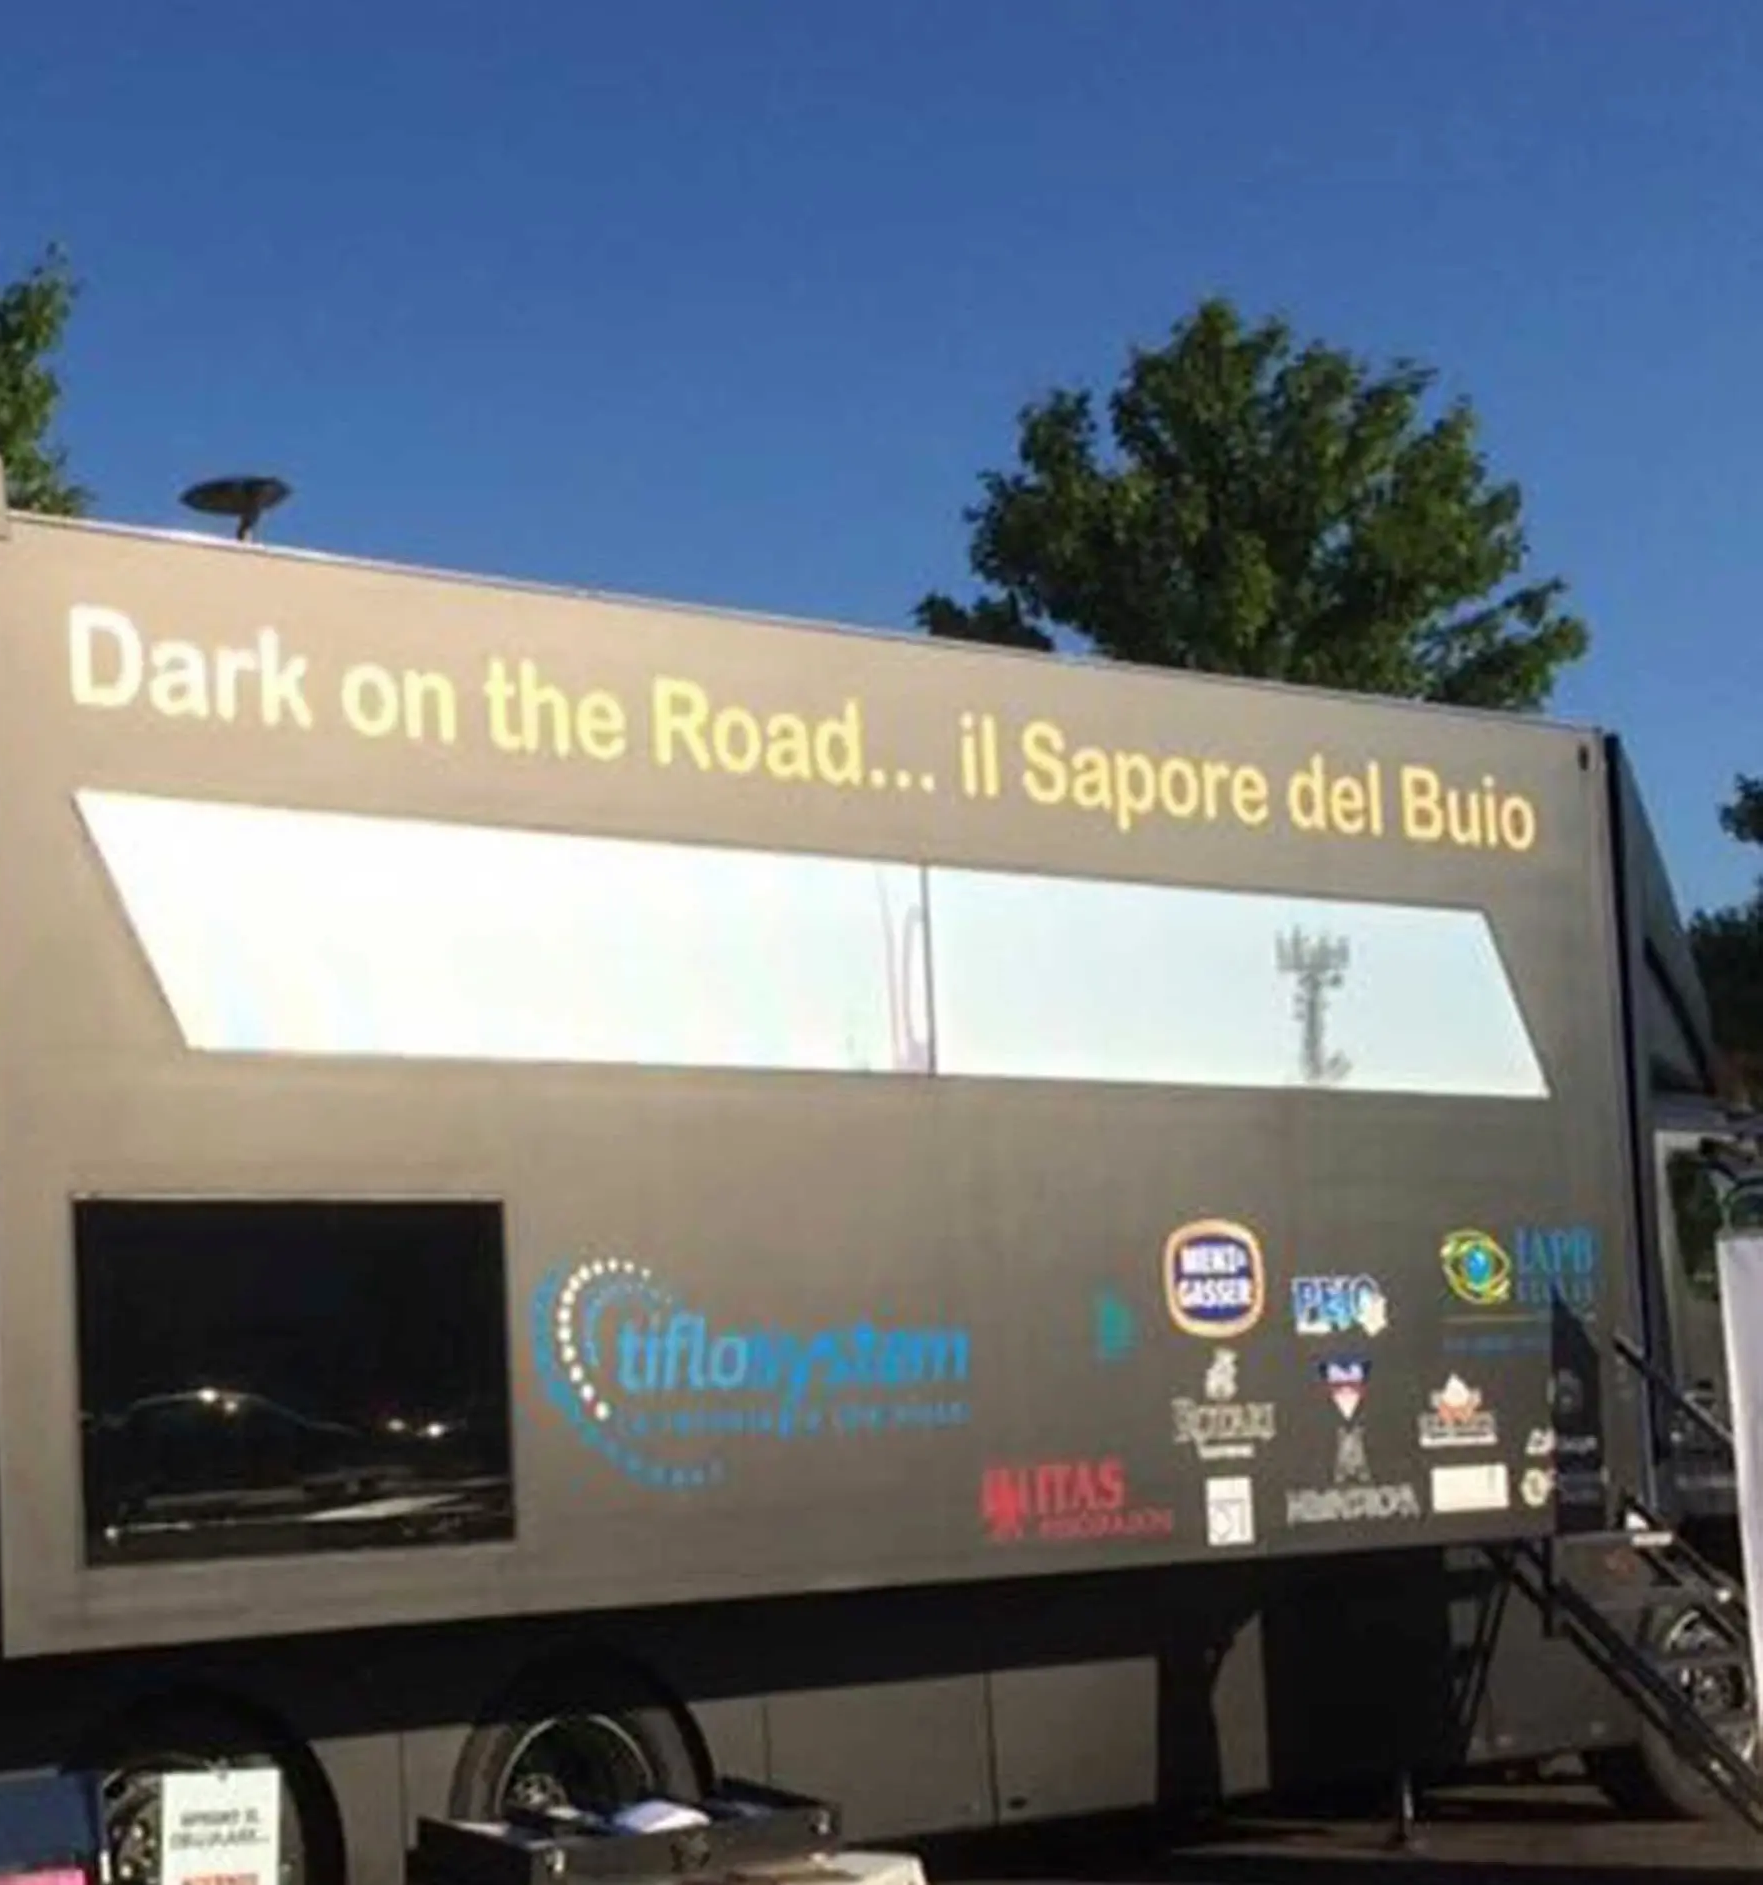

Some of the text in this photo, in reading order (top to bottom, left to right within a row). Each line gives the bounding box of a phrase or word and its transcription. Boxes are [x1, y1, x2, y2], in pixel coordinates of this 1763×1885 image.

[69, 602, 1536, 852] Dark on the Road... il Sapore del Buio
[1037, 1462, 1123, 1516] ITAS
